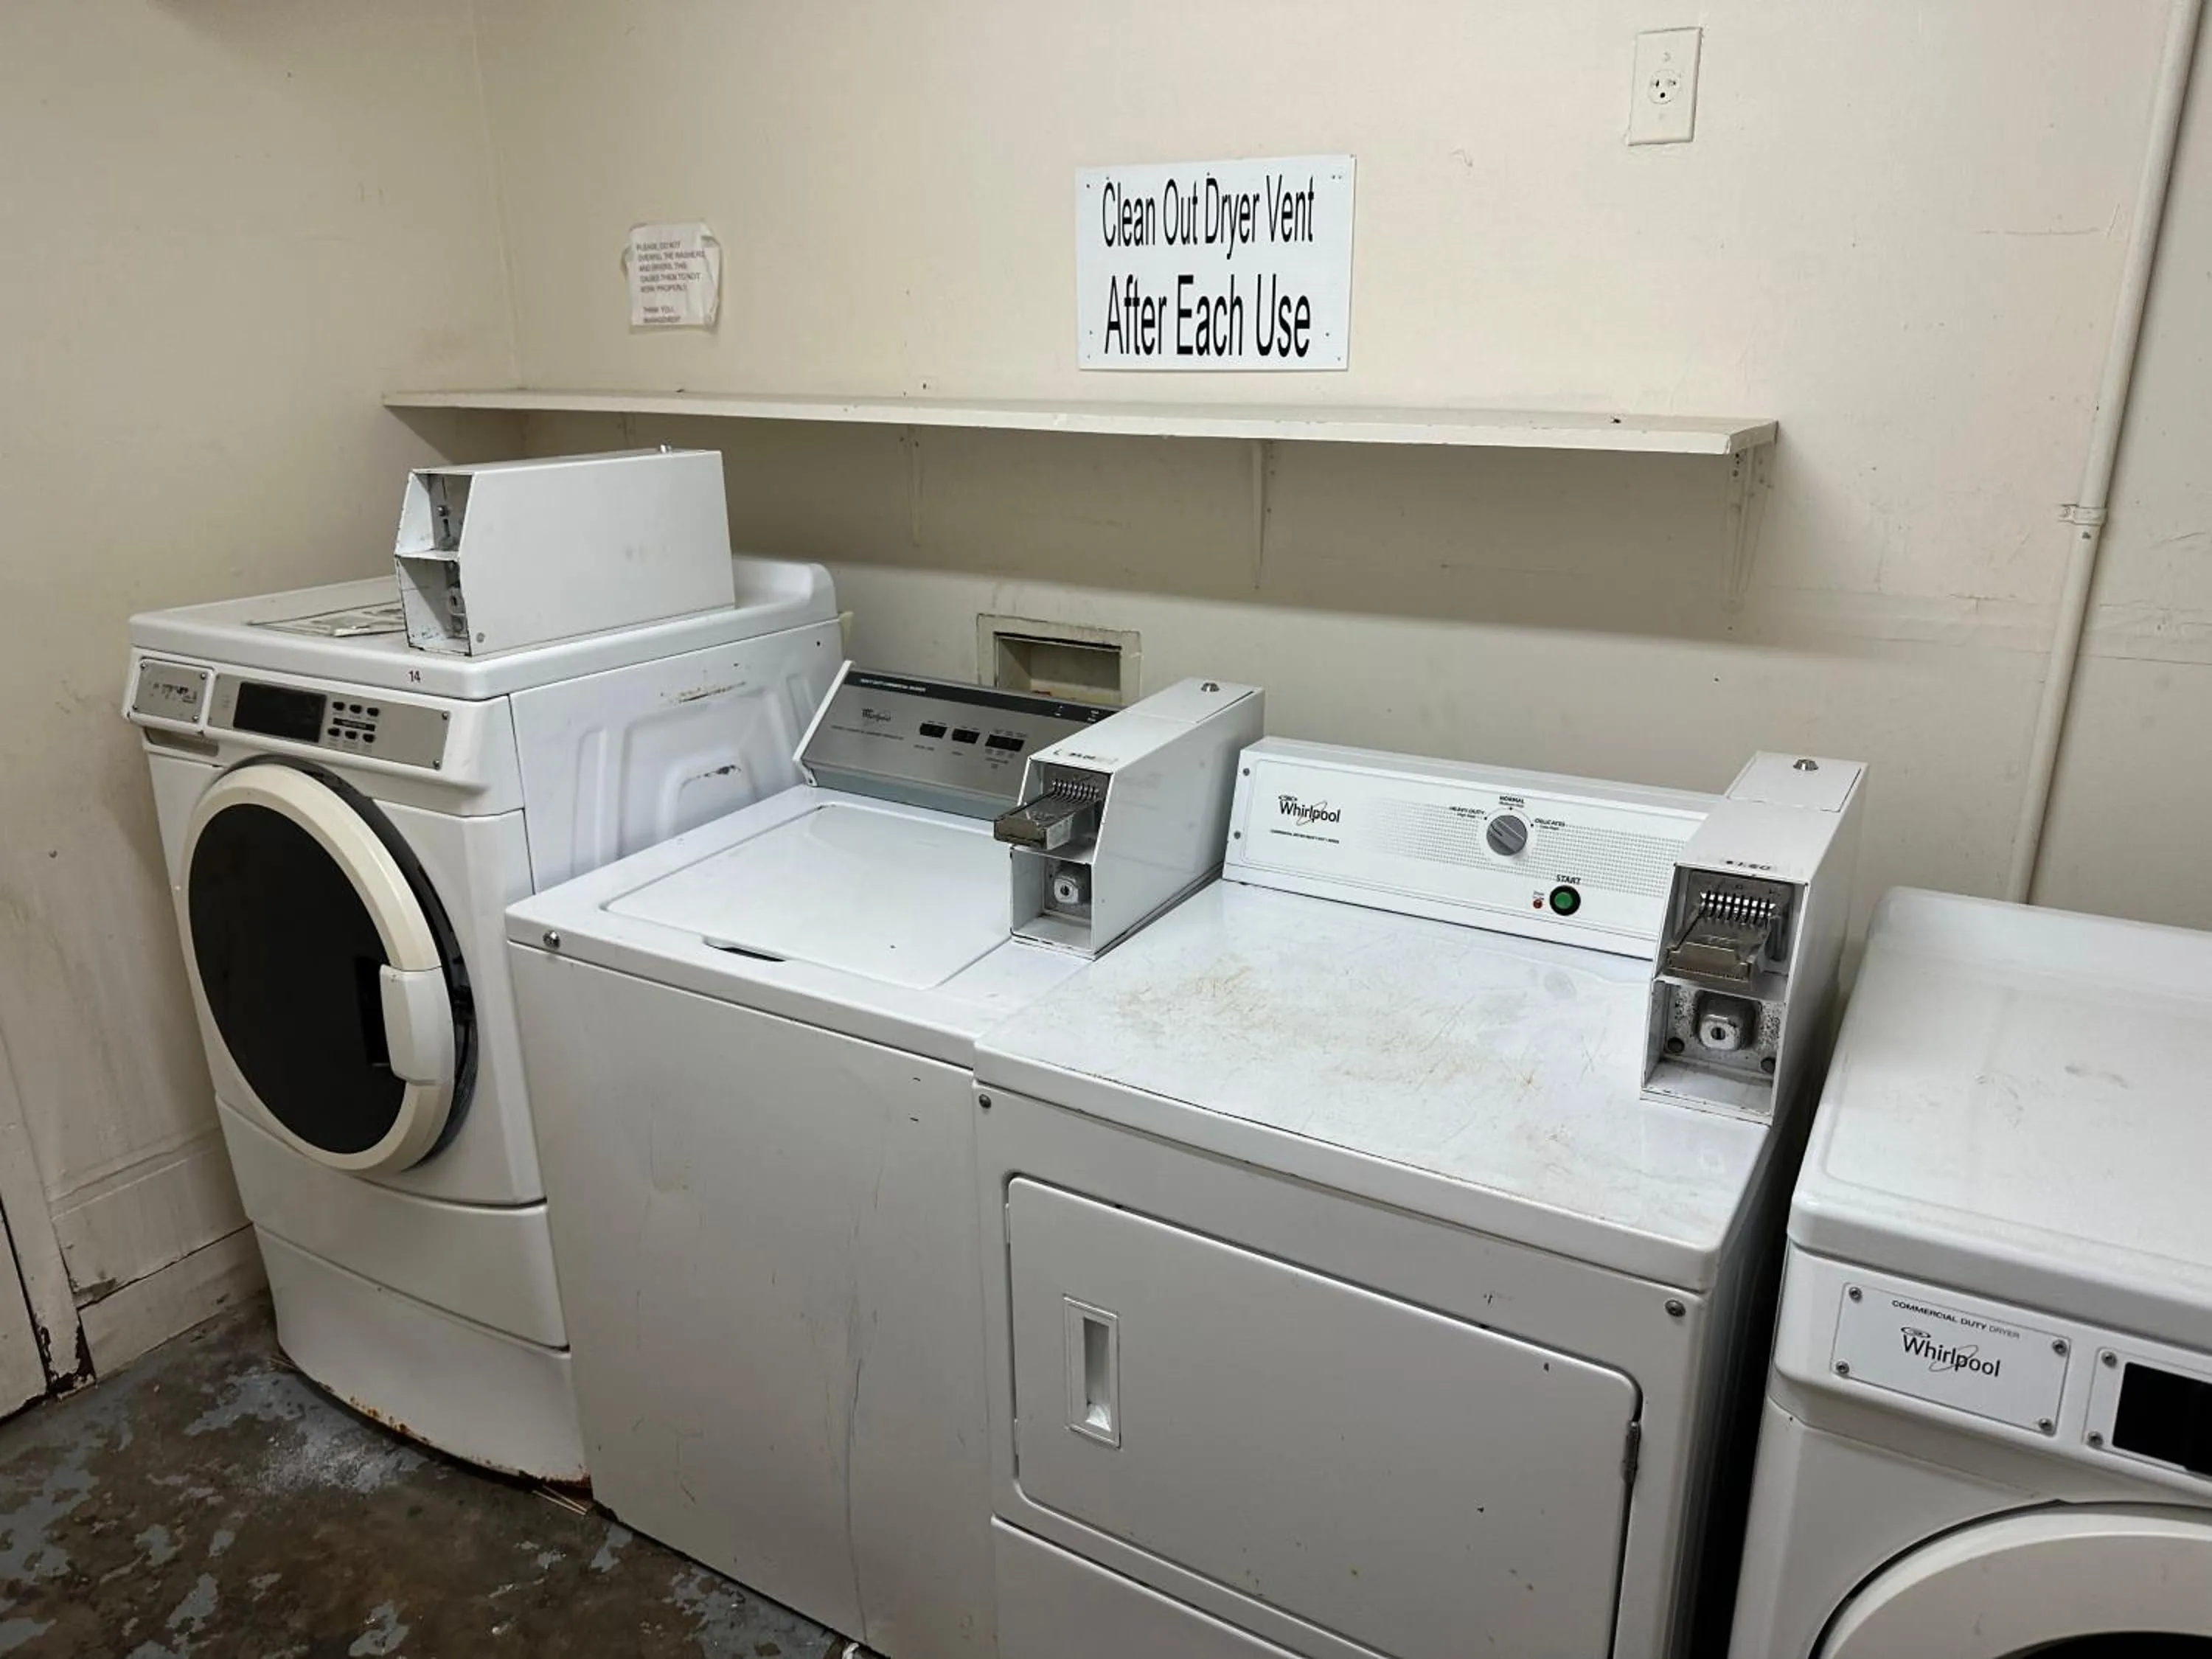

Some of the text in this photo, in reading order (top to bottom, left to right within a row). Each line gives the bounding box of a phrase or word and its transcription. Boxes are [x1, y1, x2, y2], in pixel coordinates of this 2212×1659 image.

[1102, 174, 1314, 260] Clean Out Dryer Vent
[1105, 274, 1310, 358] After Each Use
[409, 670, 420, 682] 14
[1279, 800, 1341, 824] Whirlpool
[1557, 874, 1581, 885] START
[1892, 1300, 2020, 1339] COMMERCIAL DUTY DRYER
[1903, 1334, 2001, 1377] Whirlpool
